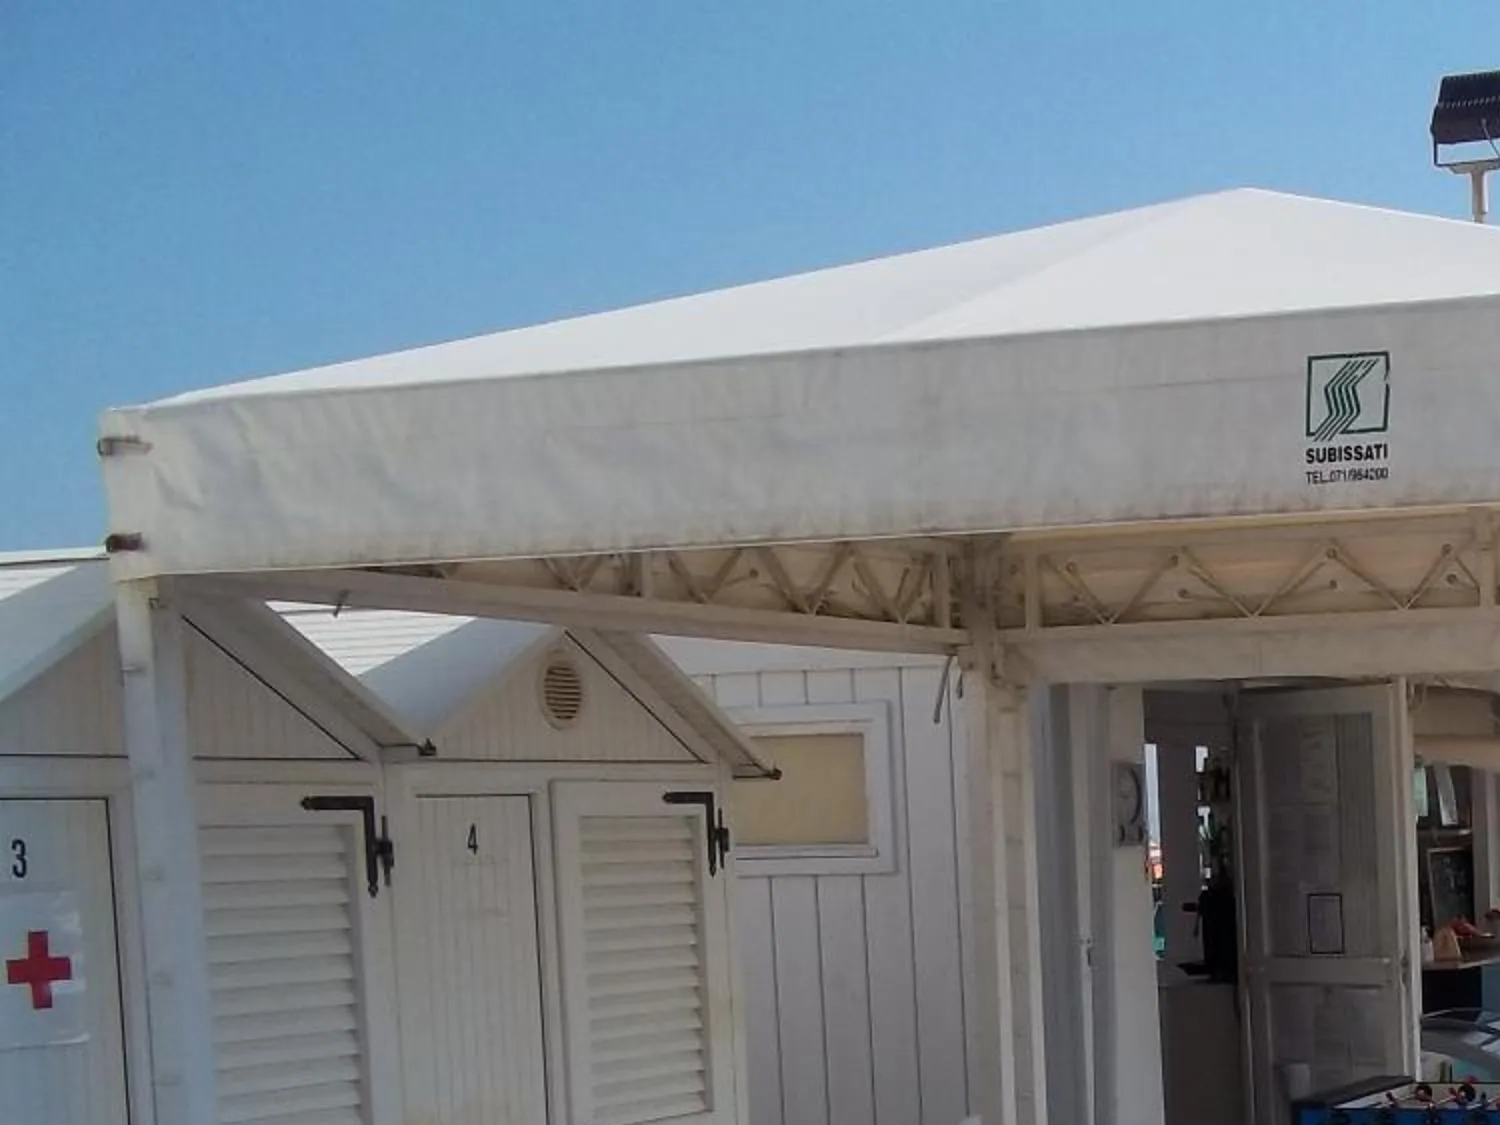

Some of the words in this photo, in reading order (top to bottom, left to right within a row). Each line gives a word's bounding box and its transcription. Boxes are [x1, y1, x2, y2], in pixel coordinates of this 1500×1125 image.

[1305, 443, 1388, 464] SUBISSATI
[467, 823, 479, 856] 4
[11, 838, 27, 879] 3
